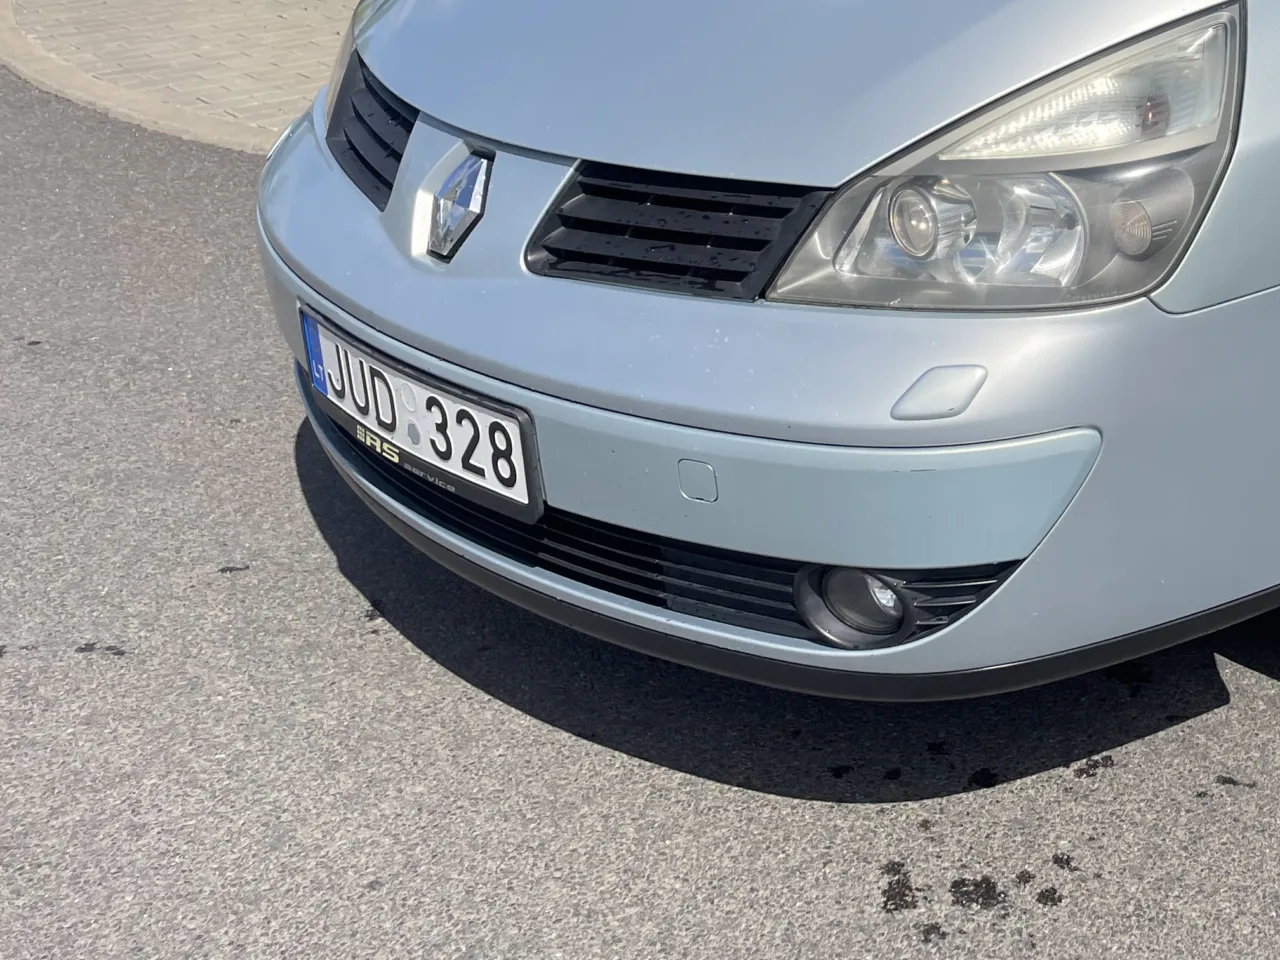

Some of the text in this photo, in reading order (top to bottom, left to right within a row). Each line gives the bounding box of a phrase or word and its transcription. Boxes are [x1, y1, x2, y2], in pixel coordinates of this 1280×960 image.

[312, 360, 324, 381] LT
[327, 343, 518, 488] JUD 328
[403, 462, 456, 492] service
